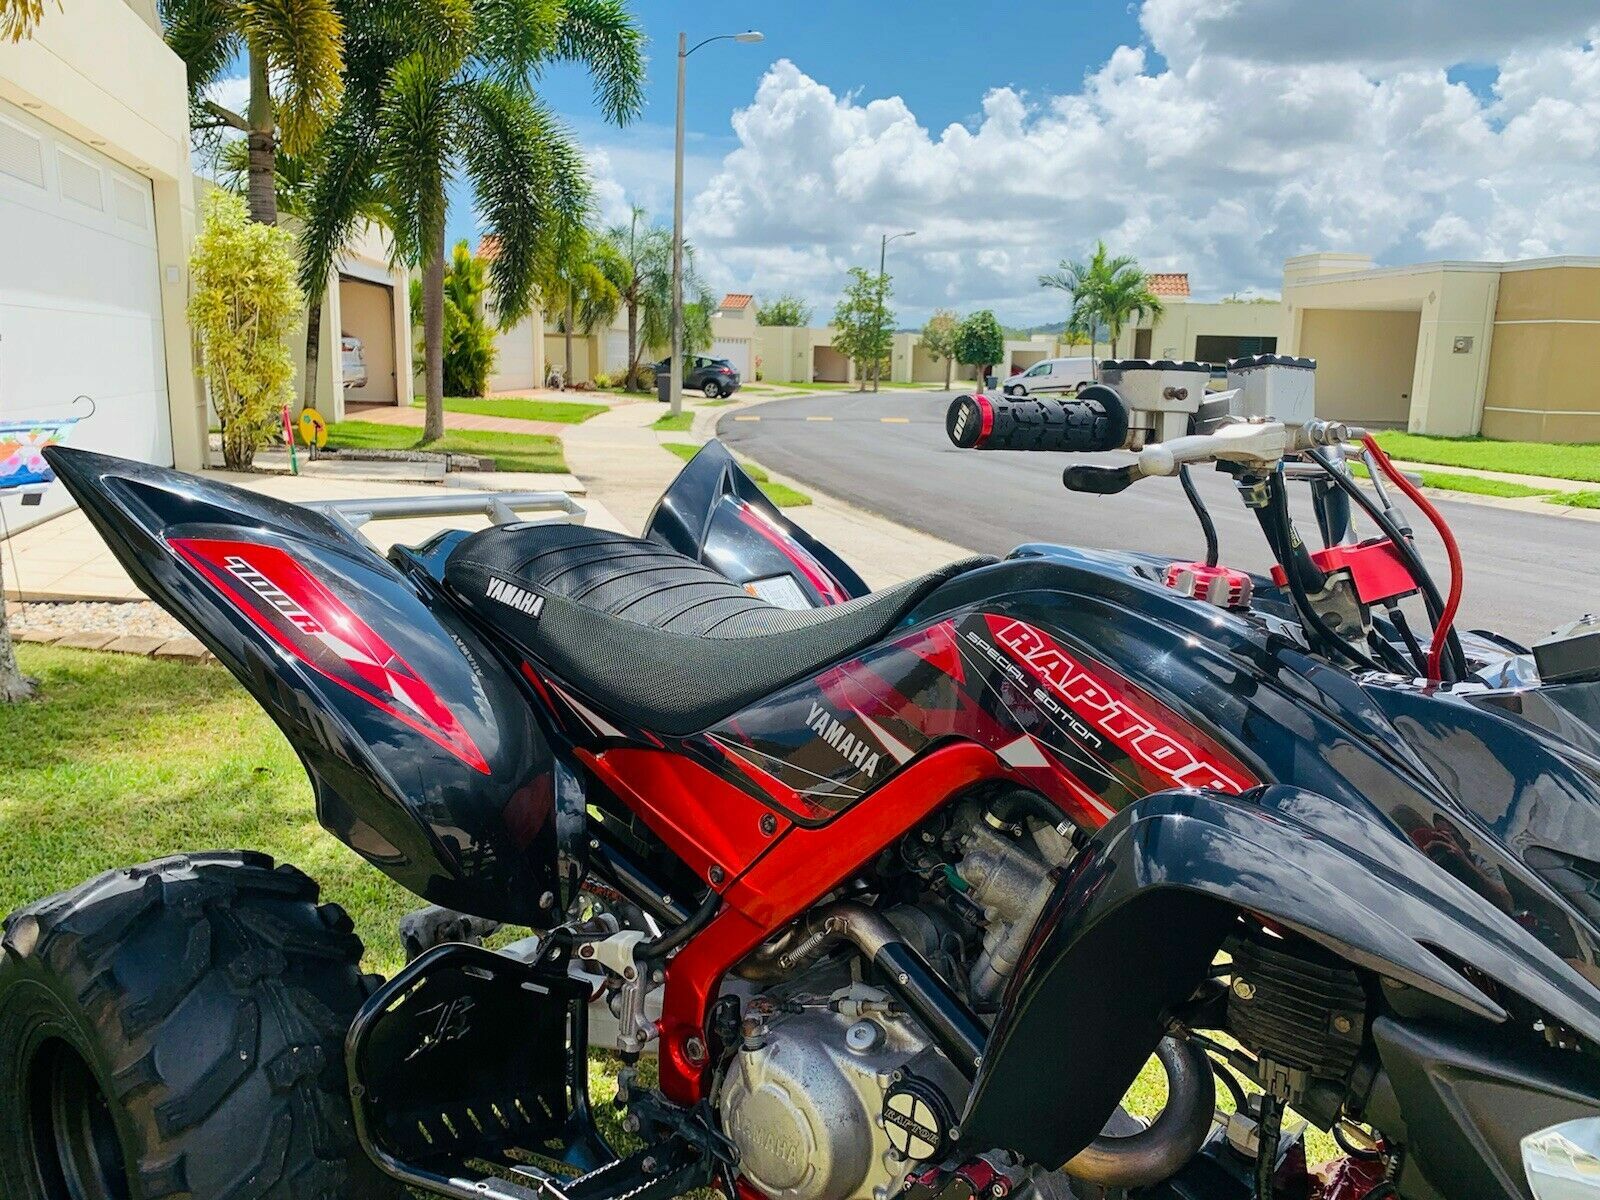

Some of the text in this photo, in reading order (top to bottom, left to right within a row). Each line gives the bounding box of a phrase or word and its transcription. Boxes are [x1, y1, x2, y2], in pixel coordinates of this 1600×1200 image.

[485, 577, 545, 617] YAMAHA
[966, 631, 1102, 748] SPECIAL EDITION
[805, 701, 880, 778] YAMAHA
[884, 1109, 939, 1144] RAPTOR
